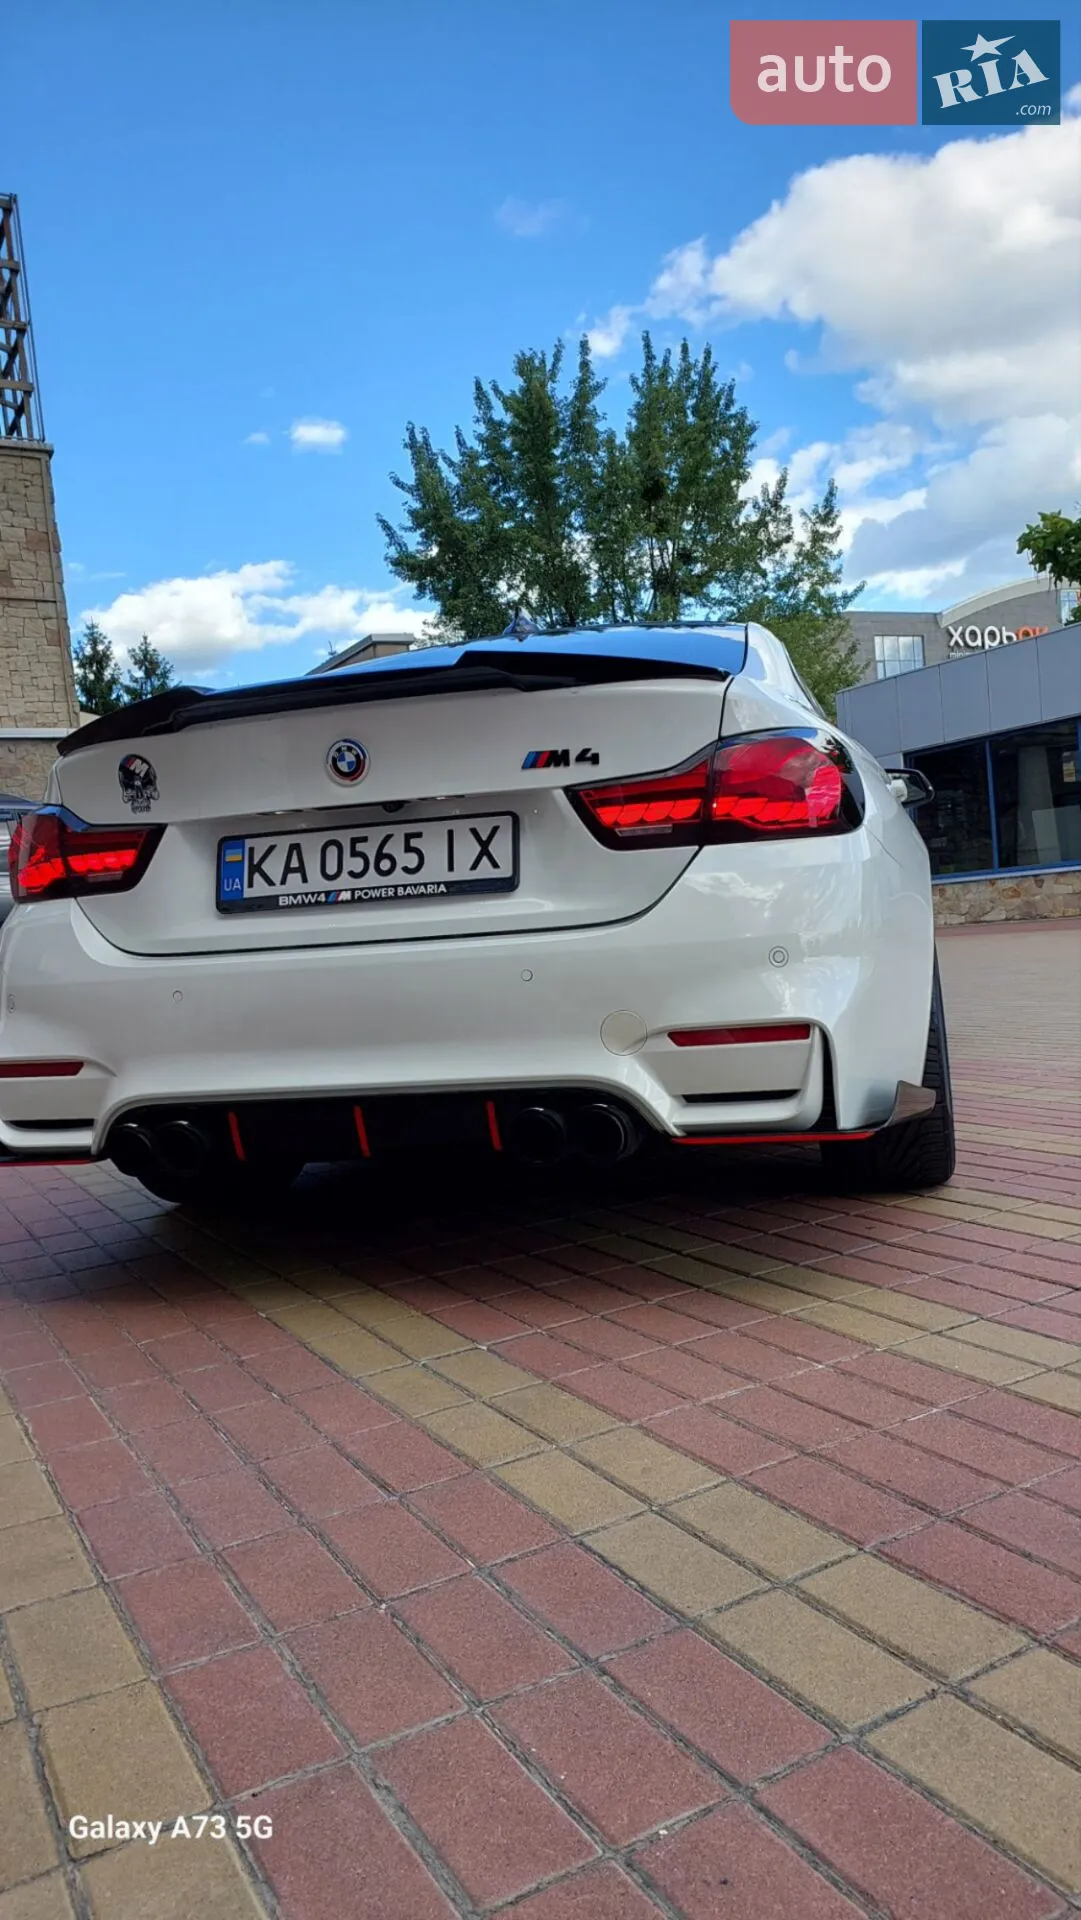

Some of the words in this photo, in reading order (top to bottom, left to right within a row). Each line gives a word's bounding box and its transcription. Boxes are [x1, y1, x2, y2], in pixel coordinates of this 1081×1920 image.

[247, 843, 309, 889] KA
[319, 831, 425, 881] 0565
[447, 825, 501, 873] IX
[223, 877, 242, 892] UA
[354, 888, 395, 900] POWER
[397, 883, 447, 896] BAVARIA
